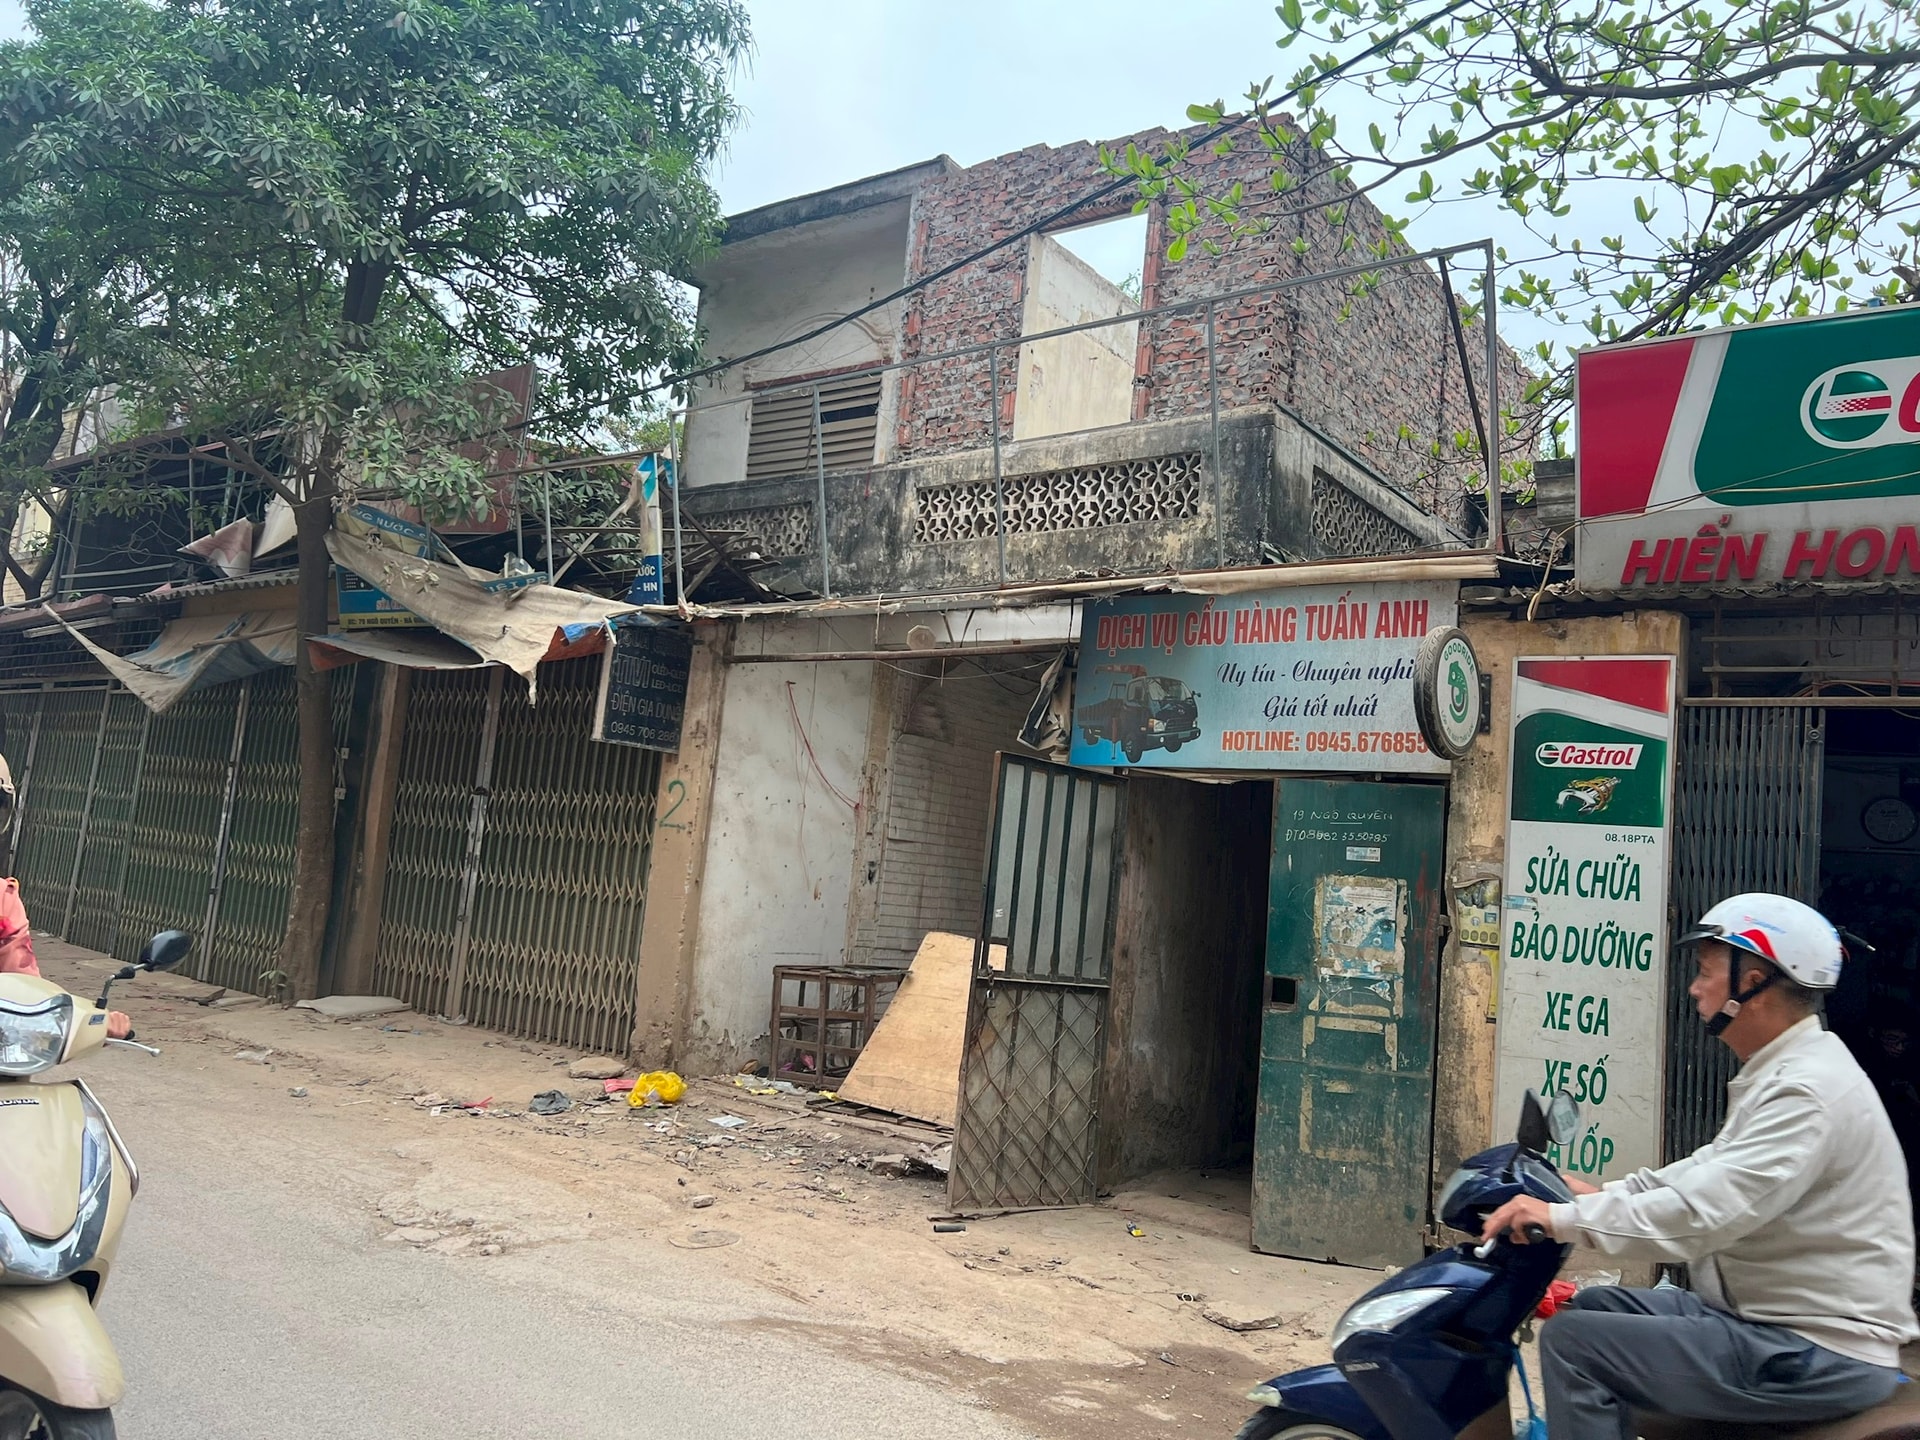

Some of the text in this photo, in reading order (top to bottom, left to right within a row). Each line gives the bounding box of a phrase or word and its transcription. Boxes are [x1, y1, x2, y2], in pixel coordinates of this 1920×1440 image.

[1620, 514, 1769, 585] HIỂN
[643, 582, 658, 592] HN
[1097, 590, 1430, 656] DỊCH VỤ CẨU HÀNG TUẤN ANH
[1251, 663, 1277, 683] tín
[1292, 659, 1362, 686] Chuyên
[1367, 657, 1415, 685] nghi
[1443, 642, 1475, 675] GOODRIDE
[610, 690, 637, 717] ĐIỆN
[637, 698, 654, 718] GIA
[1262, 693, 1379, 722] Giá tốt nhất
[610, 721, 636, 736] 0945
[1222, 730, 1300, 752] HOTLINE:
[1560, 745, 1635, 766] Castrol
[659, 780, 686, 830] 2
[1293, 810, 1304, 820] 19
[1604, 833, 1655, 844] 08.18PTA
[1525, 846, 1641, 902] SỬA CHỮA
[1510, 911, 1653, 971] BẢO DƯỠNG
[1542, 991, 1610, 1037] XE GA
[1574, 1054, 1609, 1106] SỐ
[1567, 1122, 1615, 1177] LỐP
